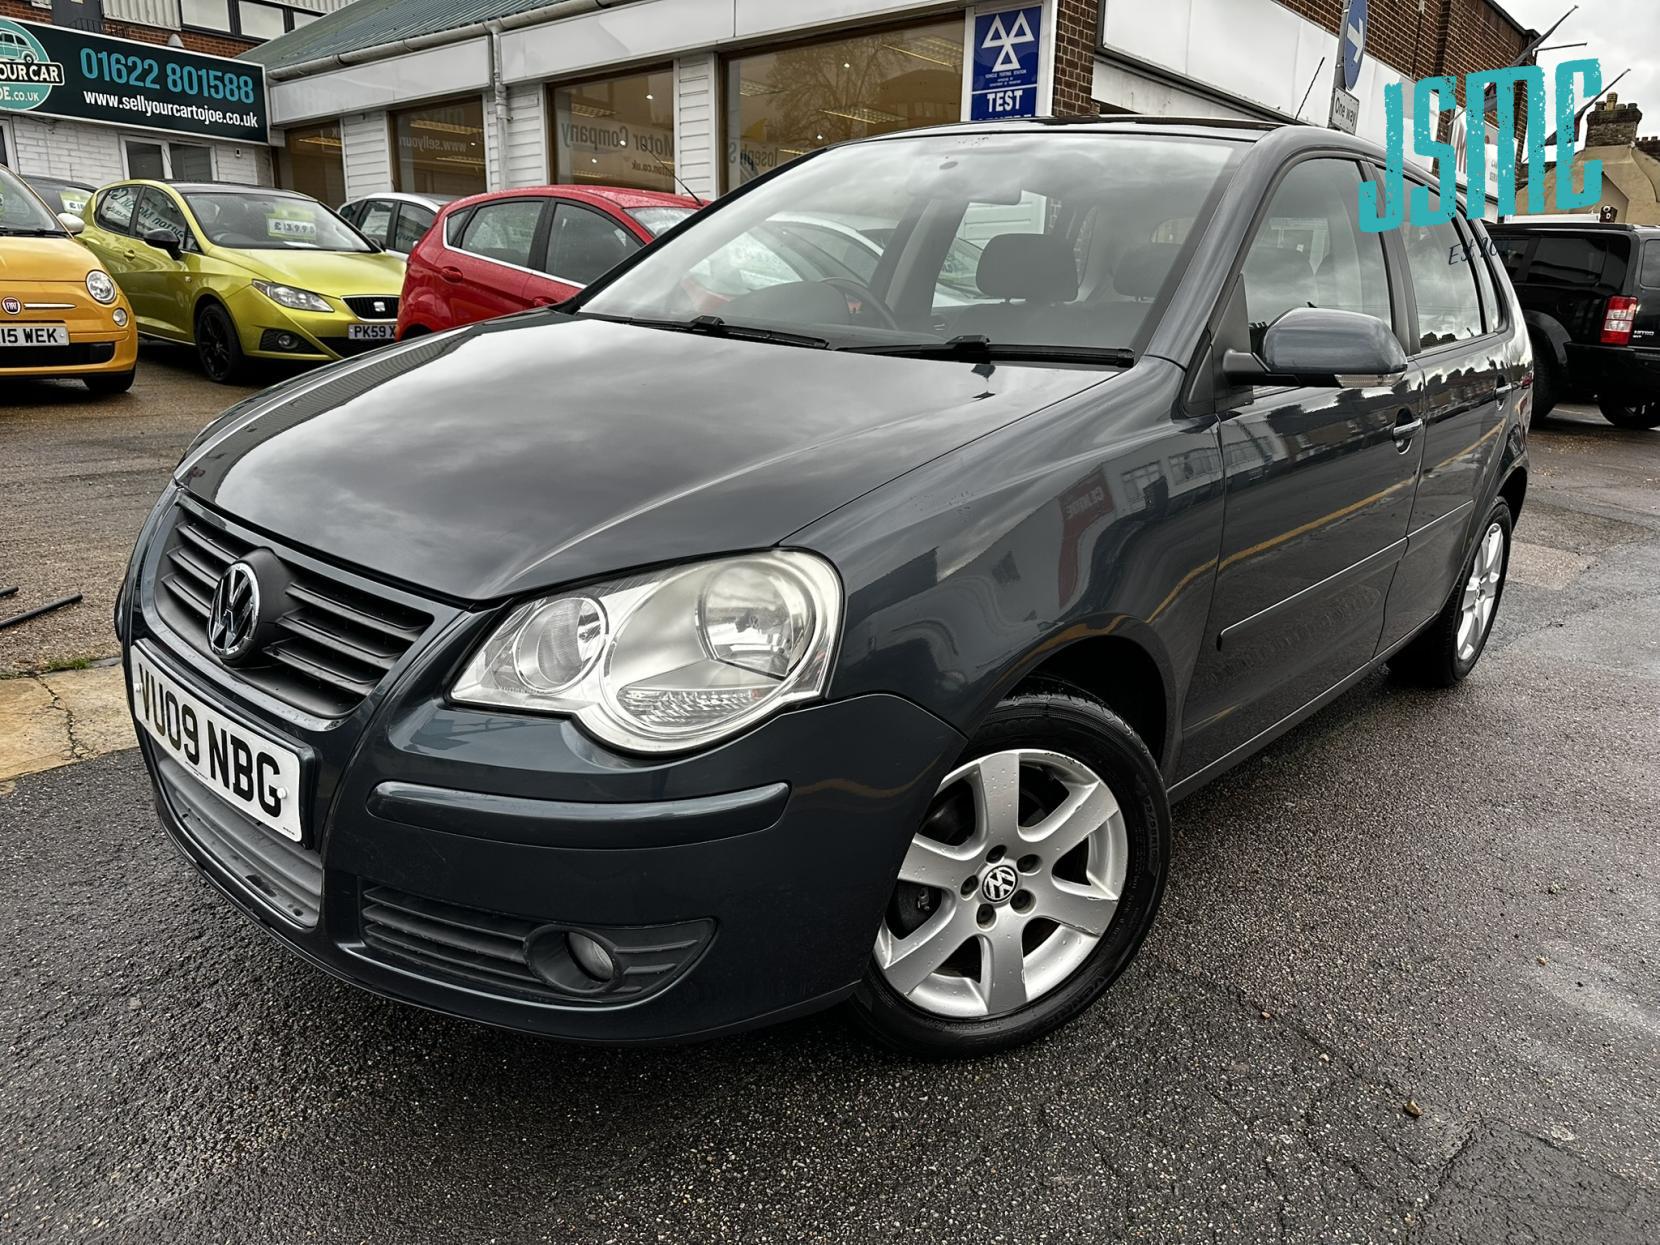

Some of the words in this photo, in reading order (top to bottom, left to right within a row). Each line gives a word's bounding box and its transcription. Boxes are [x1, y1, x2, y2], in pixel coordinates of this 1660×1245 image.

[29, 65, 60, 82] CAR
[80, 47, 161, 89] 01622
[166, 63, 255, 104] 801588
[83, 90, 259, 129] www.sellyourcartojoe.co.uk
[987, 90, 1023, 112] TEST
[1335, 96, 1345, 118] One
[1346, 107, 1356, 127] way
[22, 328, 58, 343] WEK
[354, 325, 386, 338] PK59
[138, 662, 201, 766] VU09
[207, 719, 282, 818] NBG
